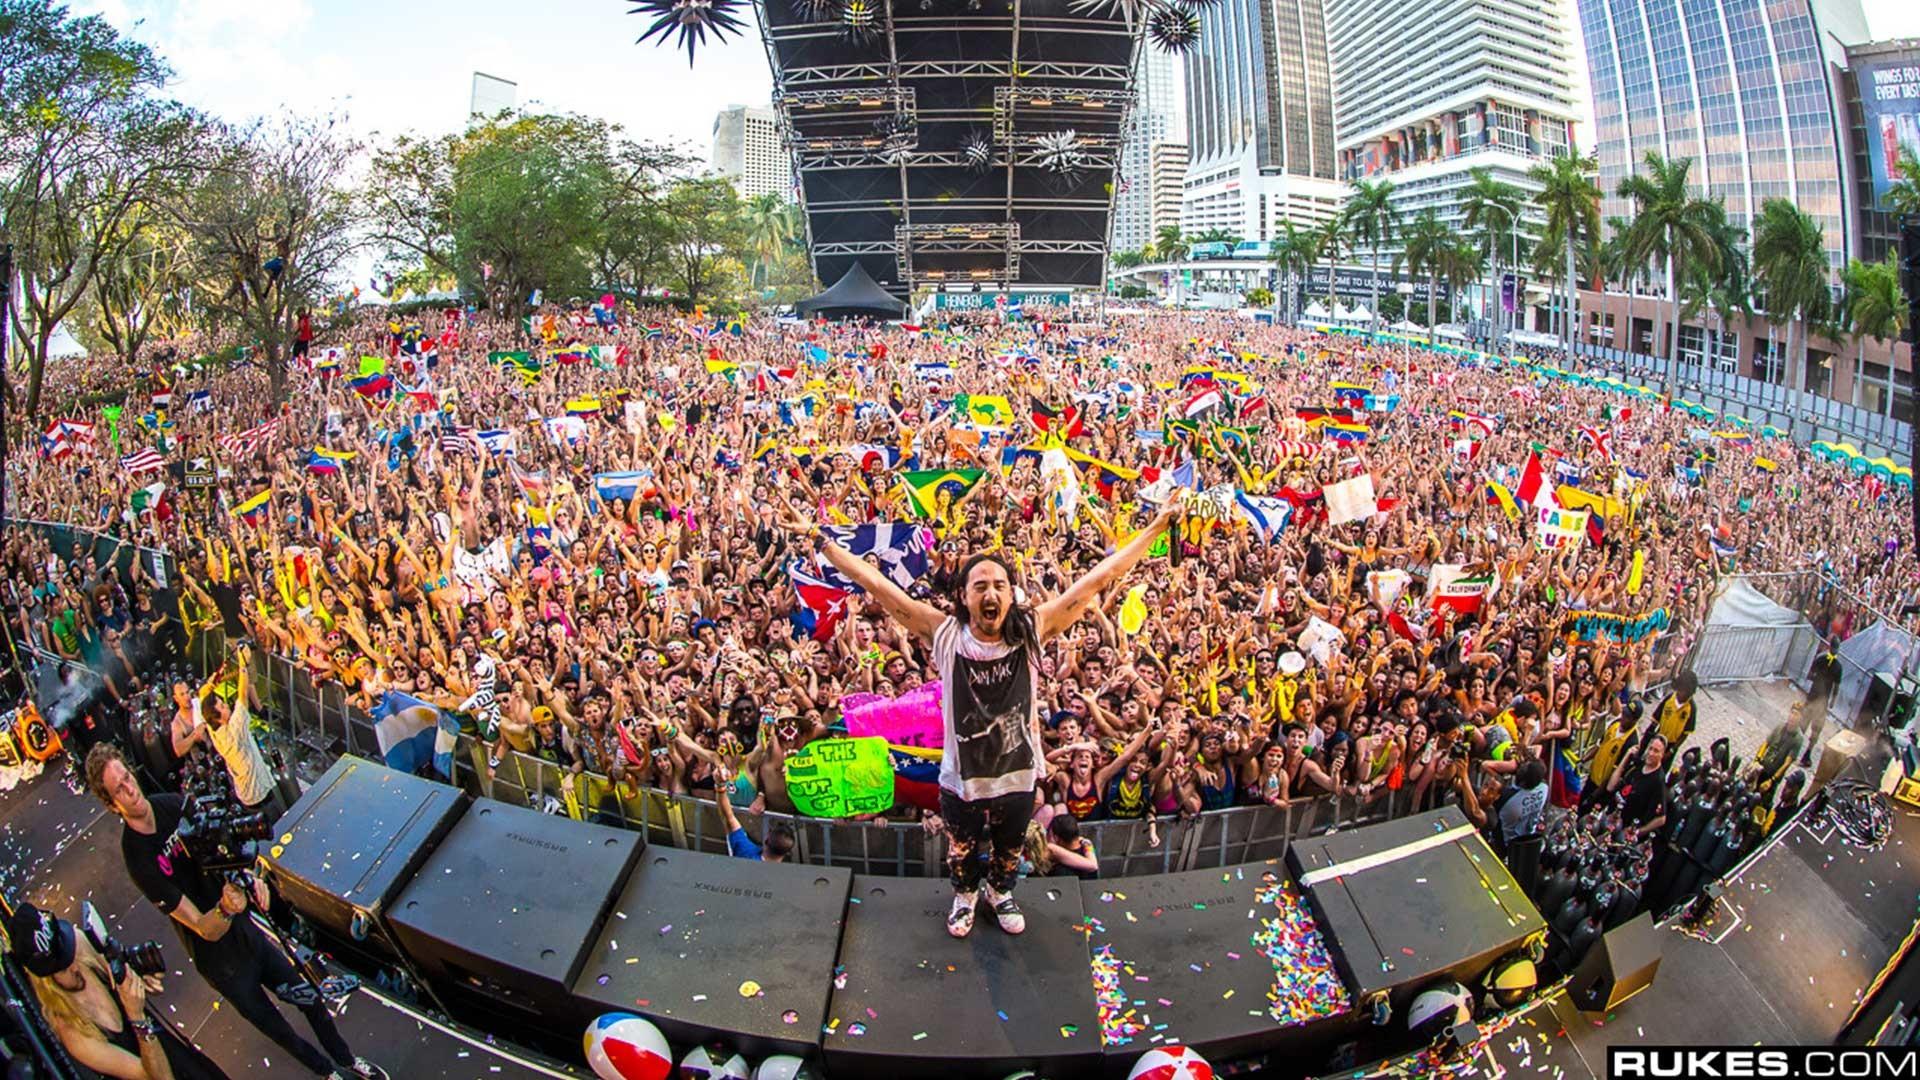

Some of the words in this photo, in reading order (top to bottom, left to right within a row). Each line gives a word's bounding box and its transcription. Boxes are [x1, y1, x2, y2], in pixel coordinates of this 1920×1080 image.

[1872, 68, 1903, 84] WINGS
[1875, 84, 1901, 100] EVERY
[1901, 82, 1920, 98] TAS
[1312, 273, 1350, 287] WELOME
[1352, 277, 1362, 287] TO
[817, 741, 857, 762] THE
[788, 777, 832, 799] OUT
[1522, 790, 1544, 806] CSC
[694, 881, 773, 900] BASSMAXX
